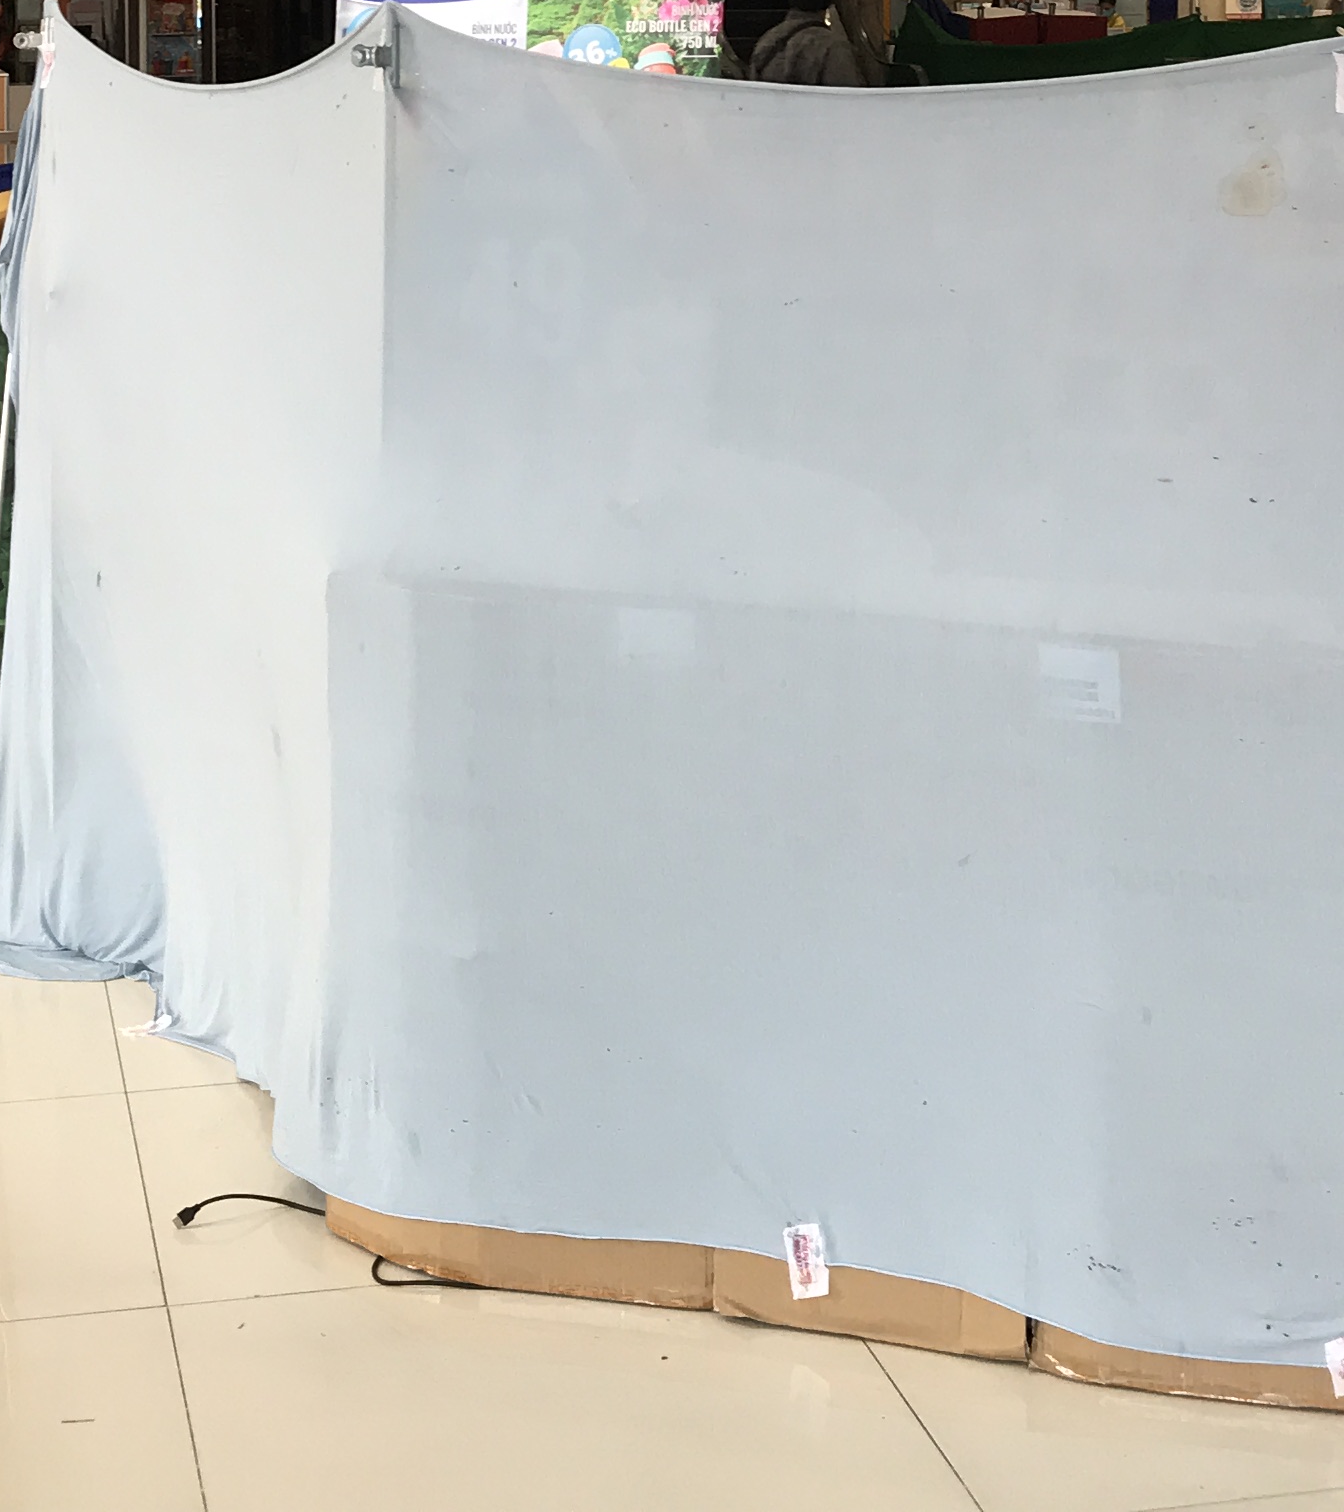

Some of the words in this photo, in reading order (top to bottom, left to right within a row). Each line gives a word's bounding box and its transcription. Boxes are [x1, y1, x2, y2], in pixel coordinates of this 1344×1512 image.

[626, 20, 647, 33] ECO
[649, 20, 687, 33] BOTTLE
[689, 20, 710, 32] GEN
[713, 20, 719, 32] 2
[683, 36, 703, 49] 750
